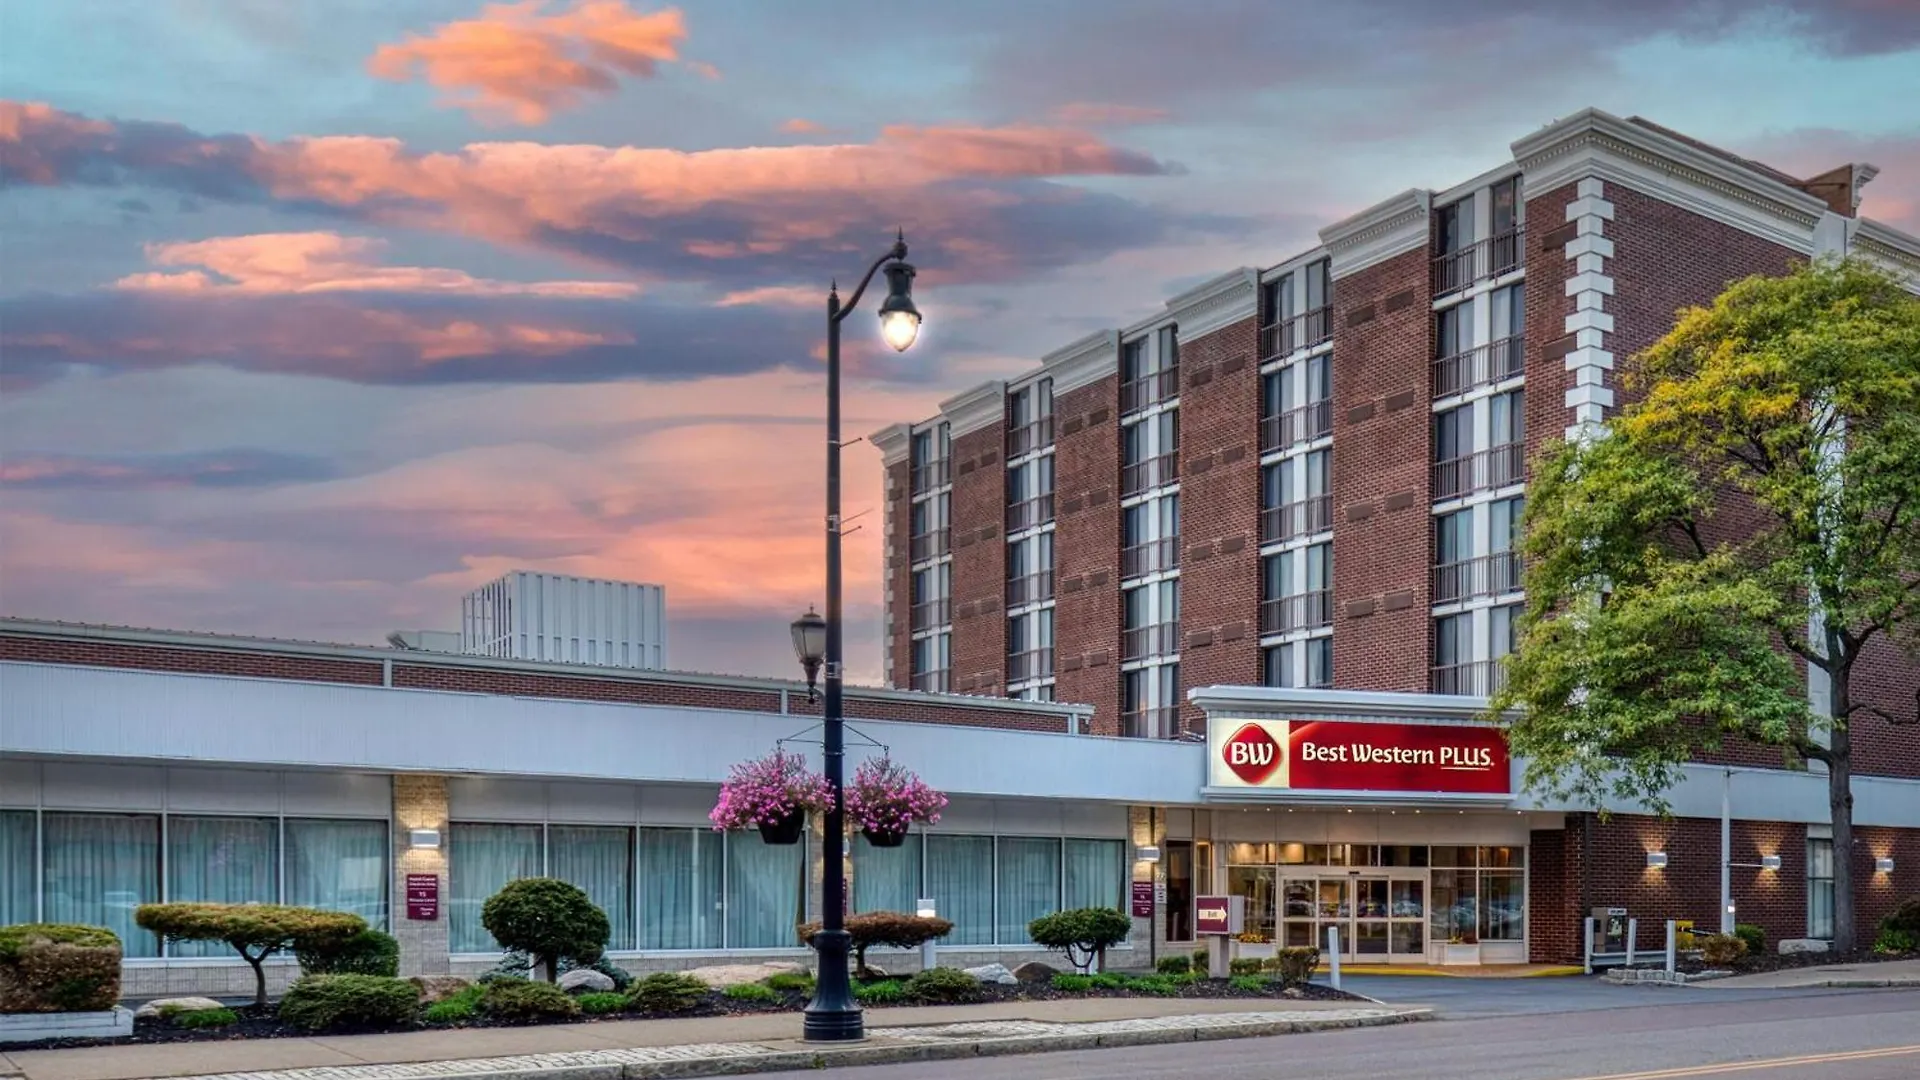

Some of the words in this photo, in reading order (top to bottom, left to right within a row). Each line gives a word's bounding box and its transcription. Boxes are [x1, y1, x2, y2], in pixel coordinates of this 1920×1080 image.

[1230, 741, 1274, 765] BW
[1302, 742, 1348, 763] Best
[1351, 744, 1435, 765] Western
